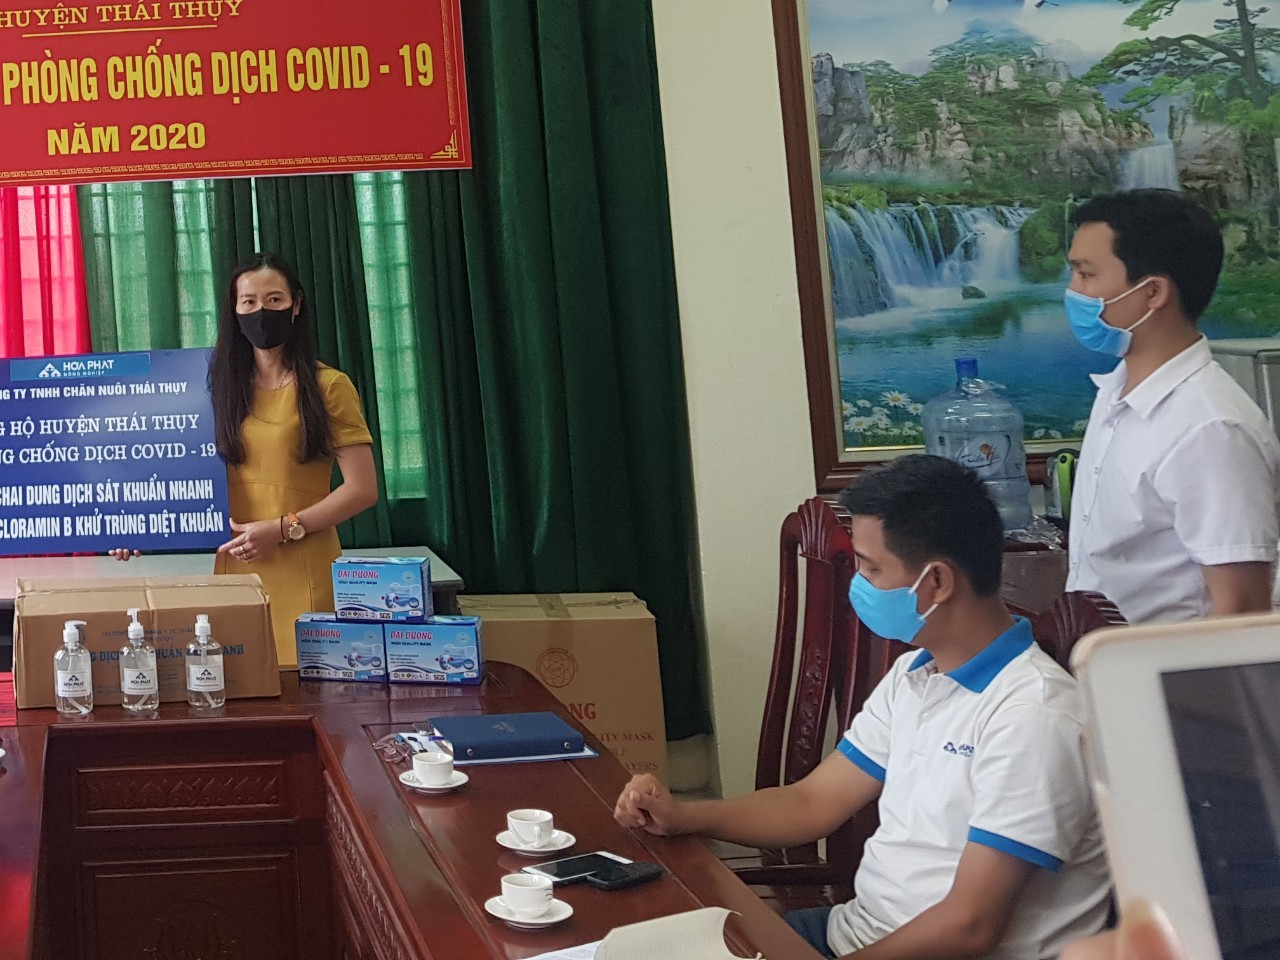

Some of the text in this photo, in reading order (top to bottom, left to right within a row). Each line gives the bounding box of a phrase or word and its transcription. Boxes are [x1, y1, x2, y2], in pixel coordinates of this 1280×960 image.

[96, 0, 161, 22] THÁI
[169, 0, 243, 20] THỤY
[2, 49, 97, 105] PHÒNG
[106, 39, 203, 99] CHỐNG
[211, 49, 278, 104] DỊCH
[287, 45, 369, 91] COVID
[399, 43, 434, 86] 19
[47, 122, 206, 155] NĂM 2020
[13, 389, 27, 399] TY
[30, 387, 60, 398] TNHH
[63, 383, 94, 397] CHĂN
[98, 383, 126, 396] NUÔI
[130, 381, 155, 394] THÁI
[158, 382, 187, 395] THỤY
[10, 416, 35, 435] HỘ
[39, 416, 100, 434] HUYỆN
[105, 412, 147, 432] THÁI
[152, 414, 199, 431] THỤY
[19, 440, 79, 464] CHỐNG
[84, 447, 127, 464] DỊCH
[131, 444, 186, 460] COVID
[200, 443, 216, 456] 19
[27, 485, 60, 504] DUNG
[63, 483, 93, 507] DỊCH
[96, 479, 119, 502] SÁT
[123, 473, 166, 502] KHUẨN
[169, 480, 213, 500] NHANH
[64, 516, 72, 536] B
[75, 507, 102, 536] KHỬ
[105, 511, 145, 535] TRÙNG
[148, 510, 176, 537] DIỆT
[180, 504, 223, 533] KHUẨN
